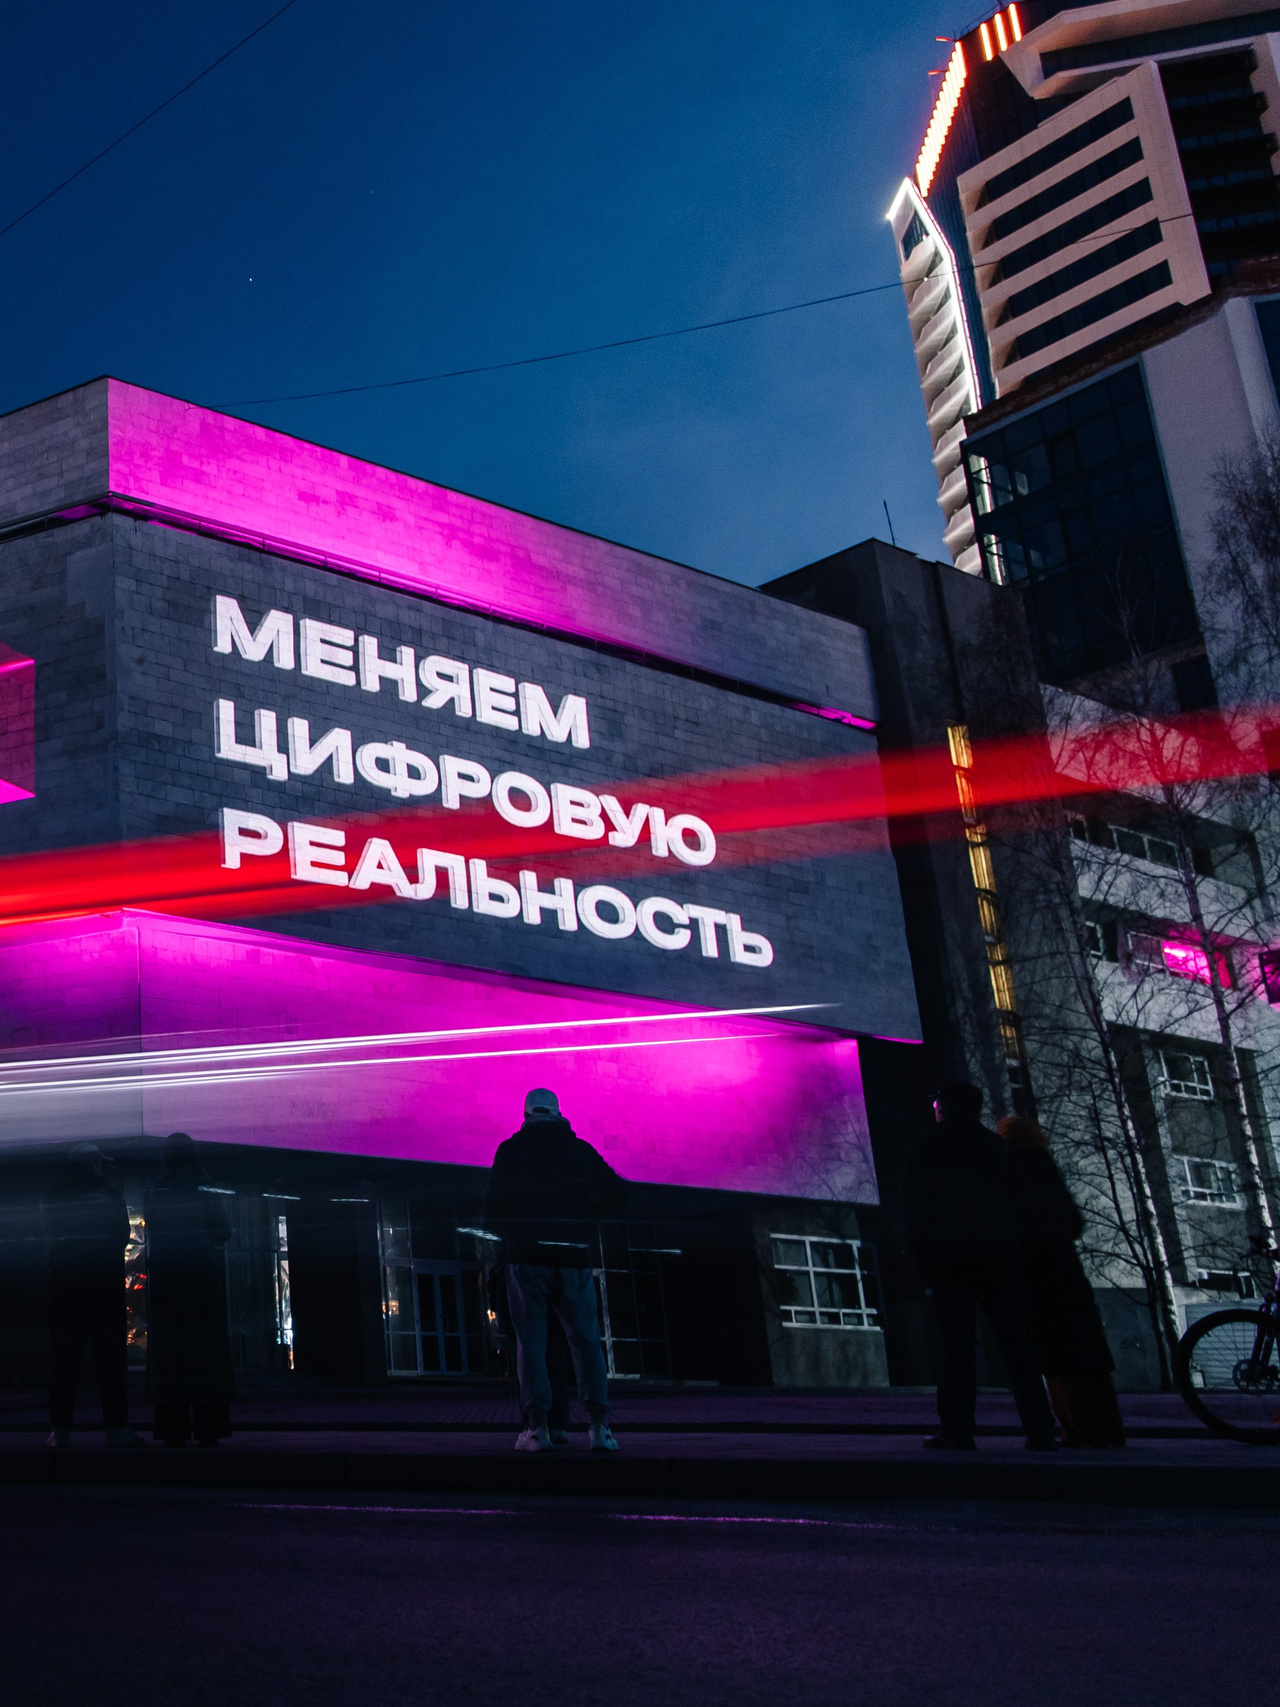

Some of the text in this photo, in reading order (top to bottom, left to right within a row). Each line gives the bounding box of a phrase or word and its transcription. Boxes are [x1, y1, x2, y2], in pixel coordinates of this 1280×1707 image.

[212, 594, 591, 749] МЕНЯЕМ
[215, 698, 718, 867] ЦИФРОВУЮ
[220, 807, 774, 969] РЕАЛЬНОСТЬ
